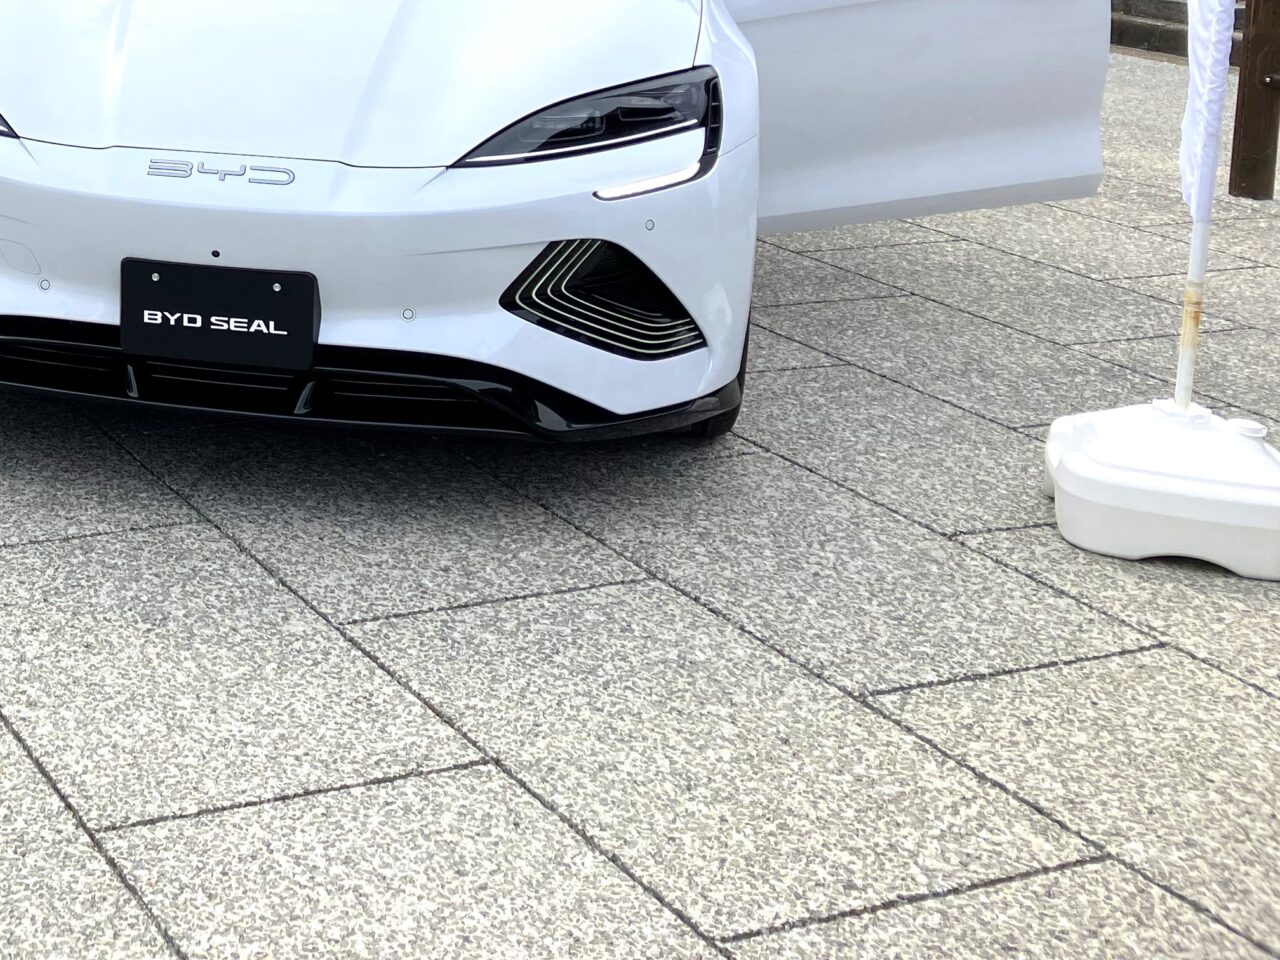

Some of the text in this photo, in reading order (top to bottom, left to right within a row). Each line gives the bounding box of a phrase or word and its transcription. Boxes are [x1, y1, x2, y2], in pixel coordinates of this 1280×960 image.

[147, 158, 296, 186] BYD
[143, 309, 288, 335] BYD SEAL
